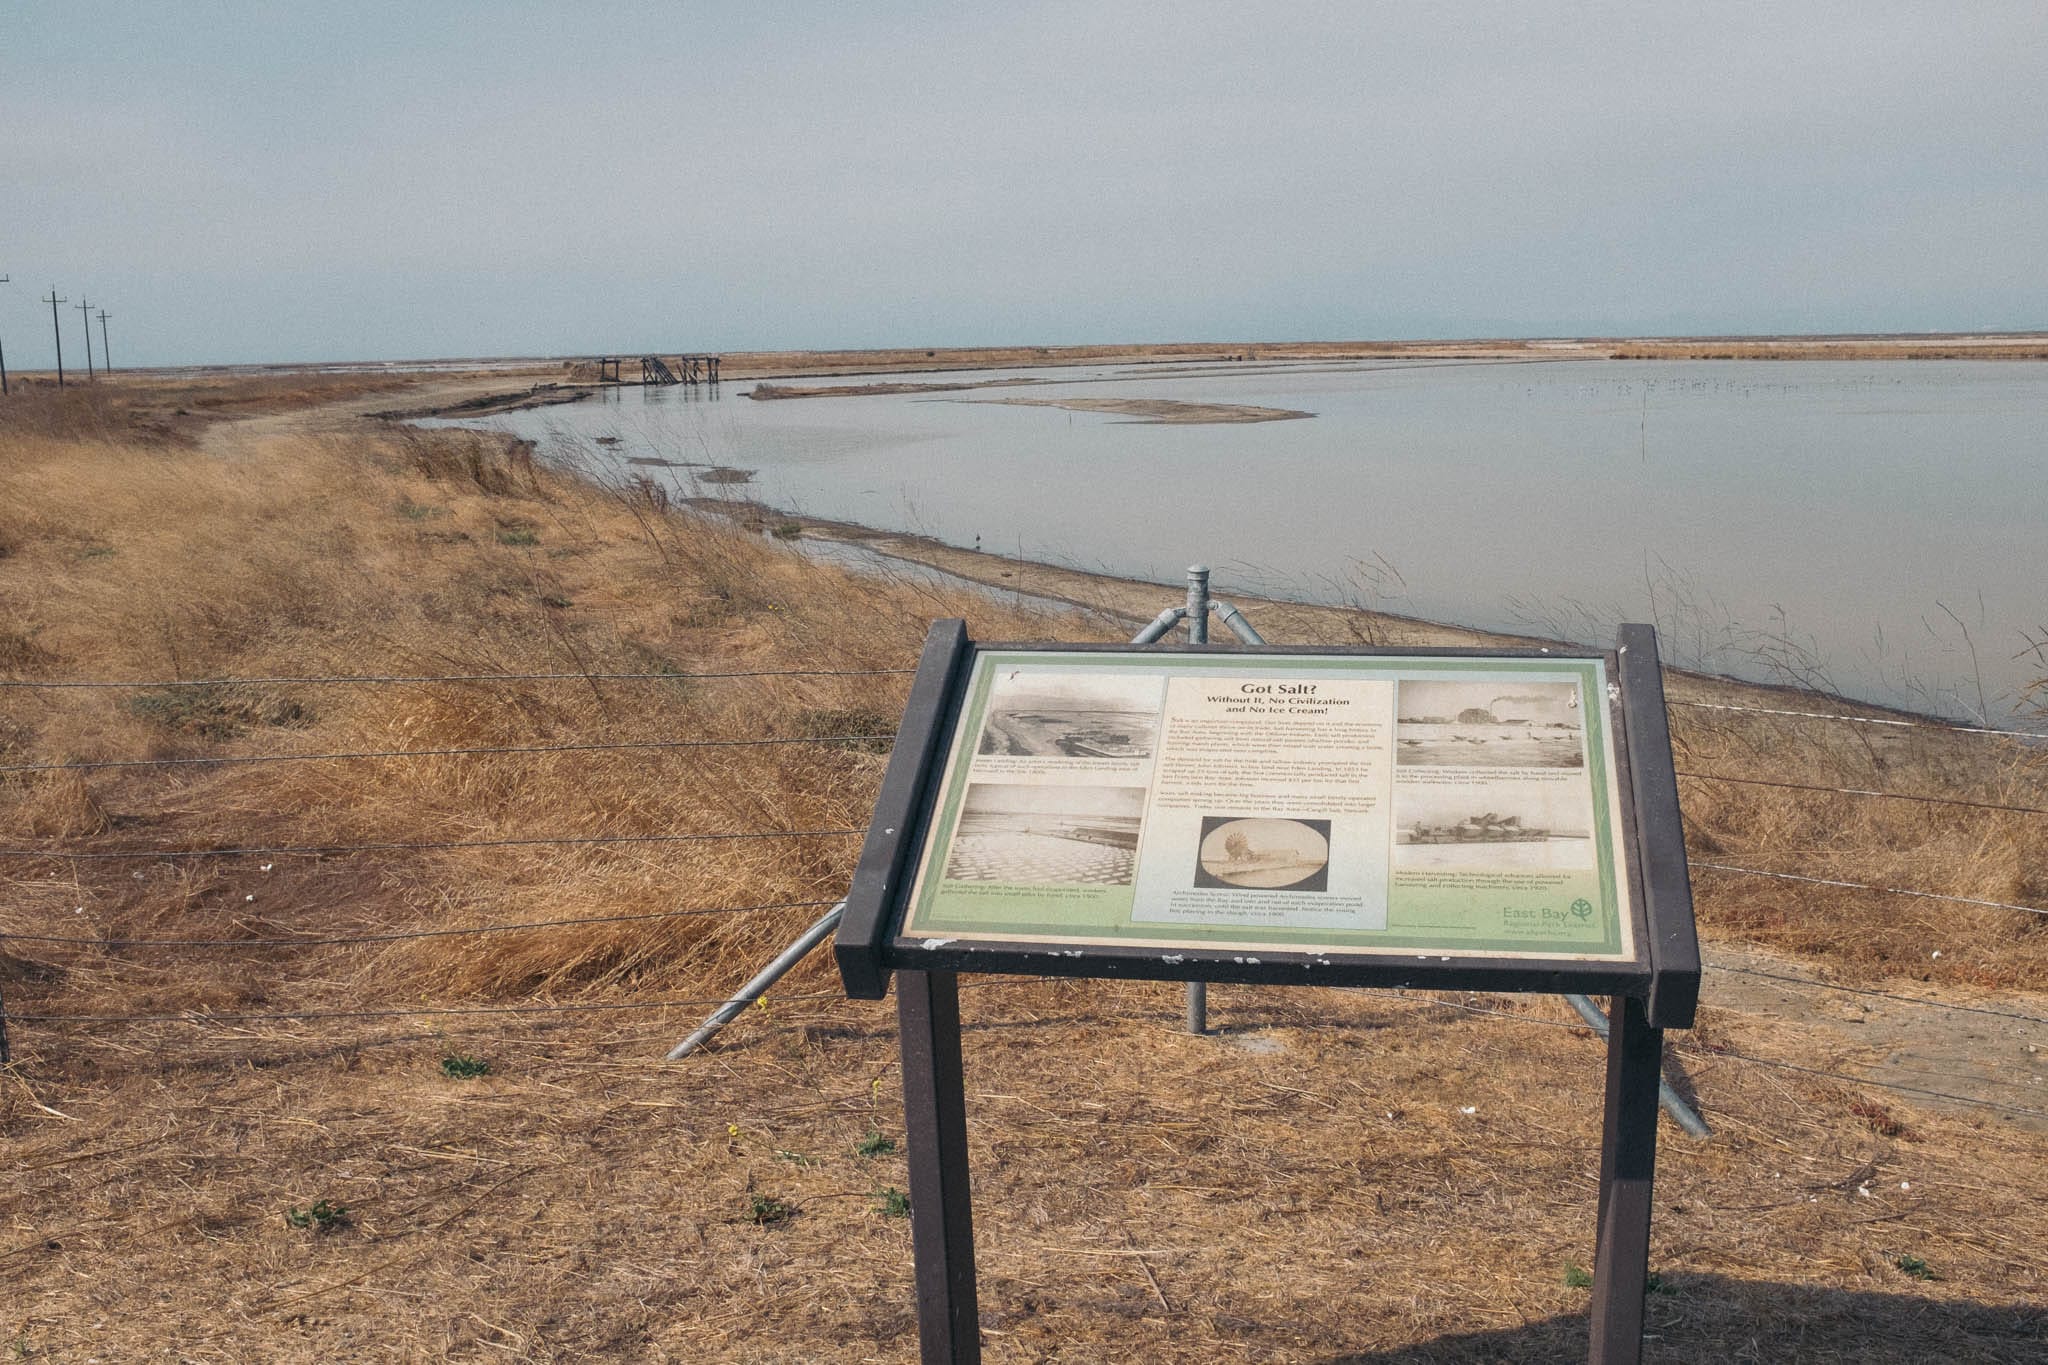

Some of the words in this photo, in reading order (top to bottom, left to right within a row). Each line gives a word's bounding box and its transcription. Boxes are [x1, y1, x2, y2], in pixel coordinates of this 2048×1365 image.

[1241, 683, 1272, 694] Got
[1278, 684, 1317, 695] Salt?
[1207, 696, 1250, 704] Without
[1254, 697, 1265, 705] It,
[1288, 697, 1350, 705] Civilization
[1288, 707, 1328, 715] Cream!
[1503, 907, 1536, 919] East
[1541, 908, 1569, 921] Bay
